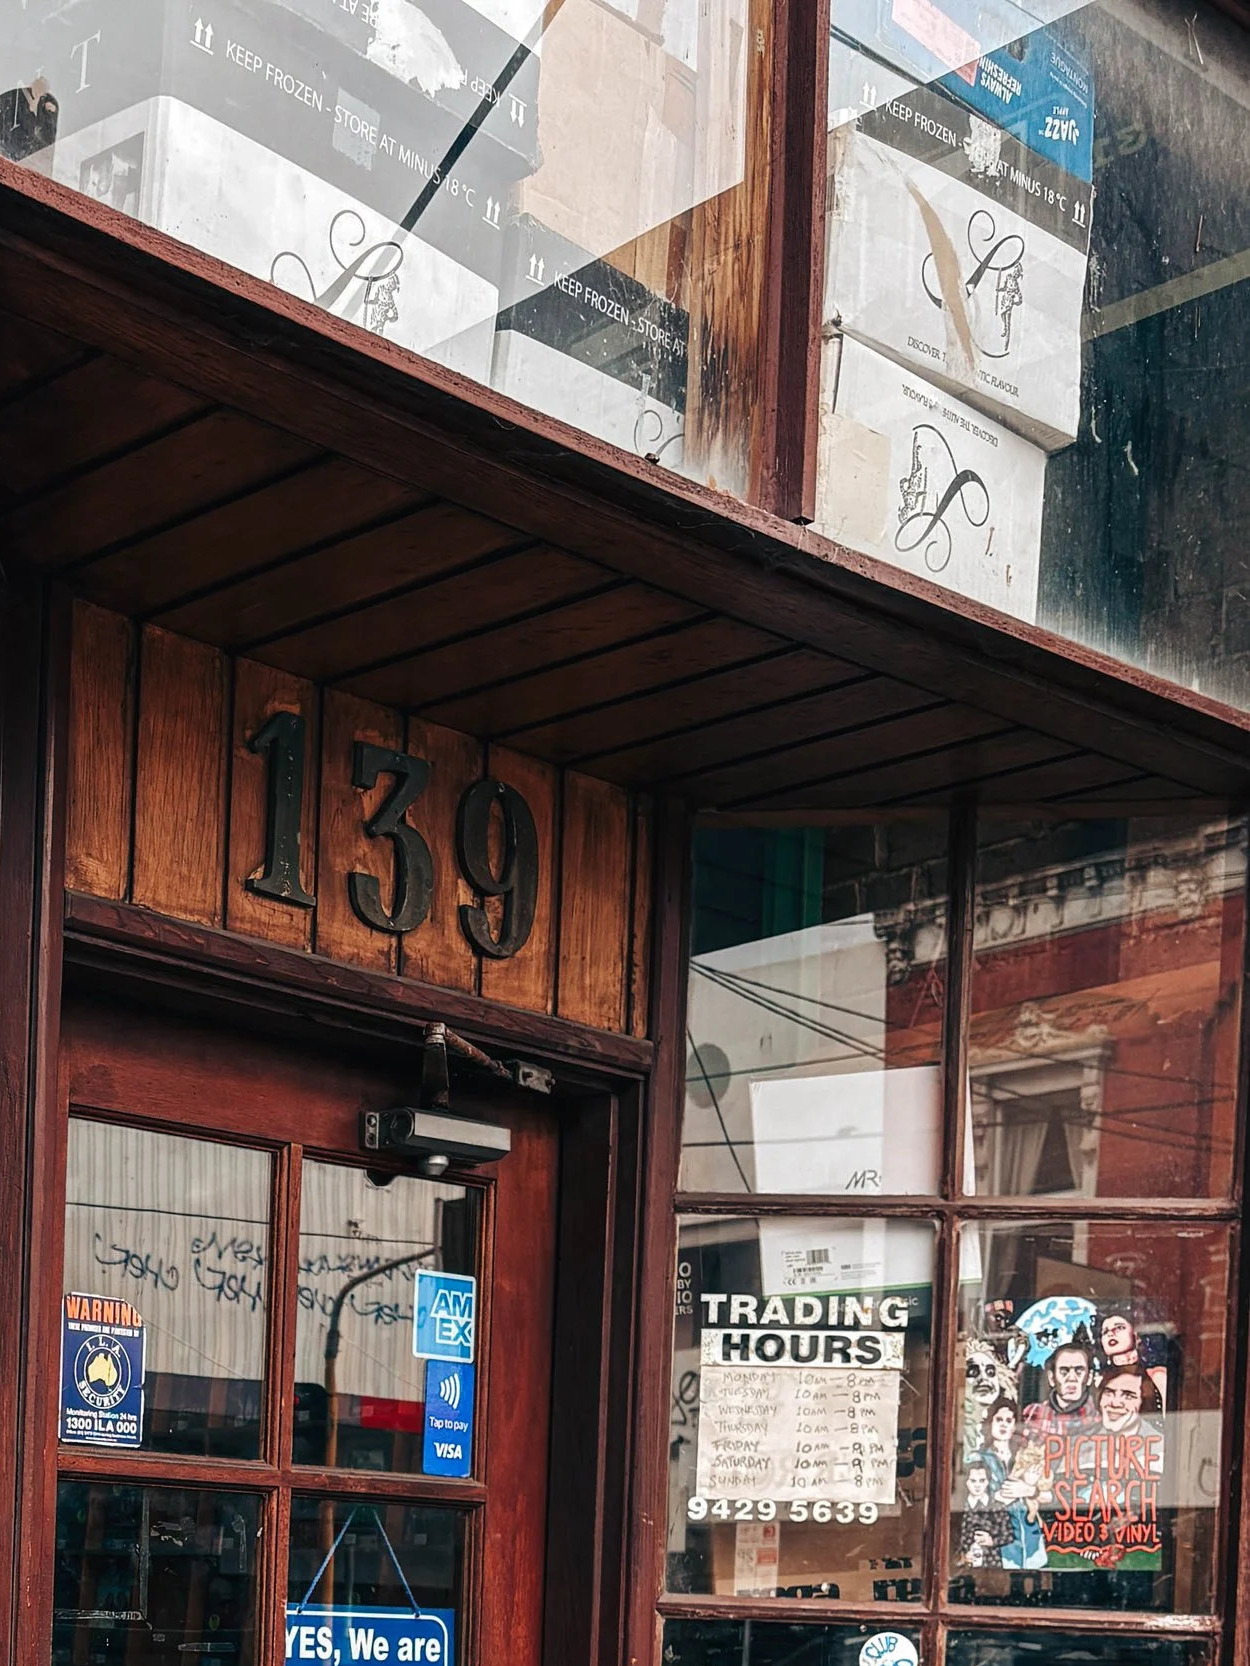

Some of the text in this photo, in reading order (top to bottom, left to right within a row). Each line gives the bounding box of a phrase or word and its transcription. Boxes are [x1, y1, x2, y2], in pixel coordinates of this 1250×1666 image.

[980, 72, 1012, 104] ALWAYS
[226, 40, 262, 72] KEEP
[265, 64, 324, 112] FROZEN
[334, 107, 377, 145] STORE
[379, 136, 397, 158] AT
[399, 147, 441, 185] MINUS
[885, 97, 912, 121] KEEP
[914, 111, 957, 148] FROZEN
[1009, 165, 1041, 195] MINUS
[1043, 186, 1054, 204] 18
[554, 271, 582, 298] KEEP
[584, 287, 629, 325] FROZEN
[637, 316, 671, 349] STORE
[246, 711, 539, 959] 139
[66, 1296, 142, 1328] WARNING
[430, 1289, 473, 1318] AM
[700, 1293, 909, 1328] TRADING
[436, 1318, 472, 1345] EX
[722, 1333, 882, 1364] HOURS
[723, 1372, 776, 1386] MONDAY
[78, 1380, 126, 1407] SECURITY
[718, 1388, 770, 1400] TUESDAY
[99, 1411, 119, 1420] Station
[717, 1405, 778, 1416] WEDNESDAY
[66, 1418, 137, 1434] 1300 ILA 000
[429, 1416, 468, 1433] Tap to pay
[714, 1421, 768, 1434] THURSDAY
[434, 1442, 462, 1460] VISA
[711, 1437, 760, 1452] FRIDAY
[1044, 1435, 1162, 1480] PICTURE
[711, 1455, 771, 1470] SATURDAY
[709, 1474, 756, 1487] SUNDAY
[687, 1497, 880, 1525] 9429 5639
[1054, 1480, 1157, 1523] SEARCH
[1042, 1521, 1161, 1543] VIDEO VINYL
[285, 1625, 441, 1666] YES, We are
[865, 1636, 898, 1658] CLUB
